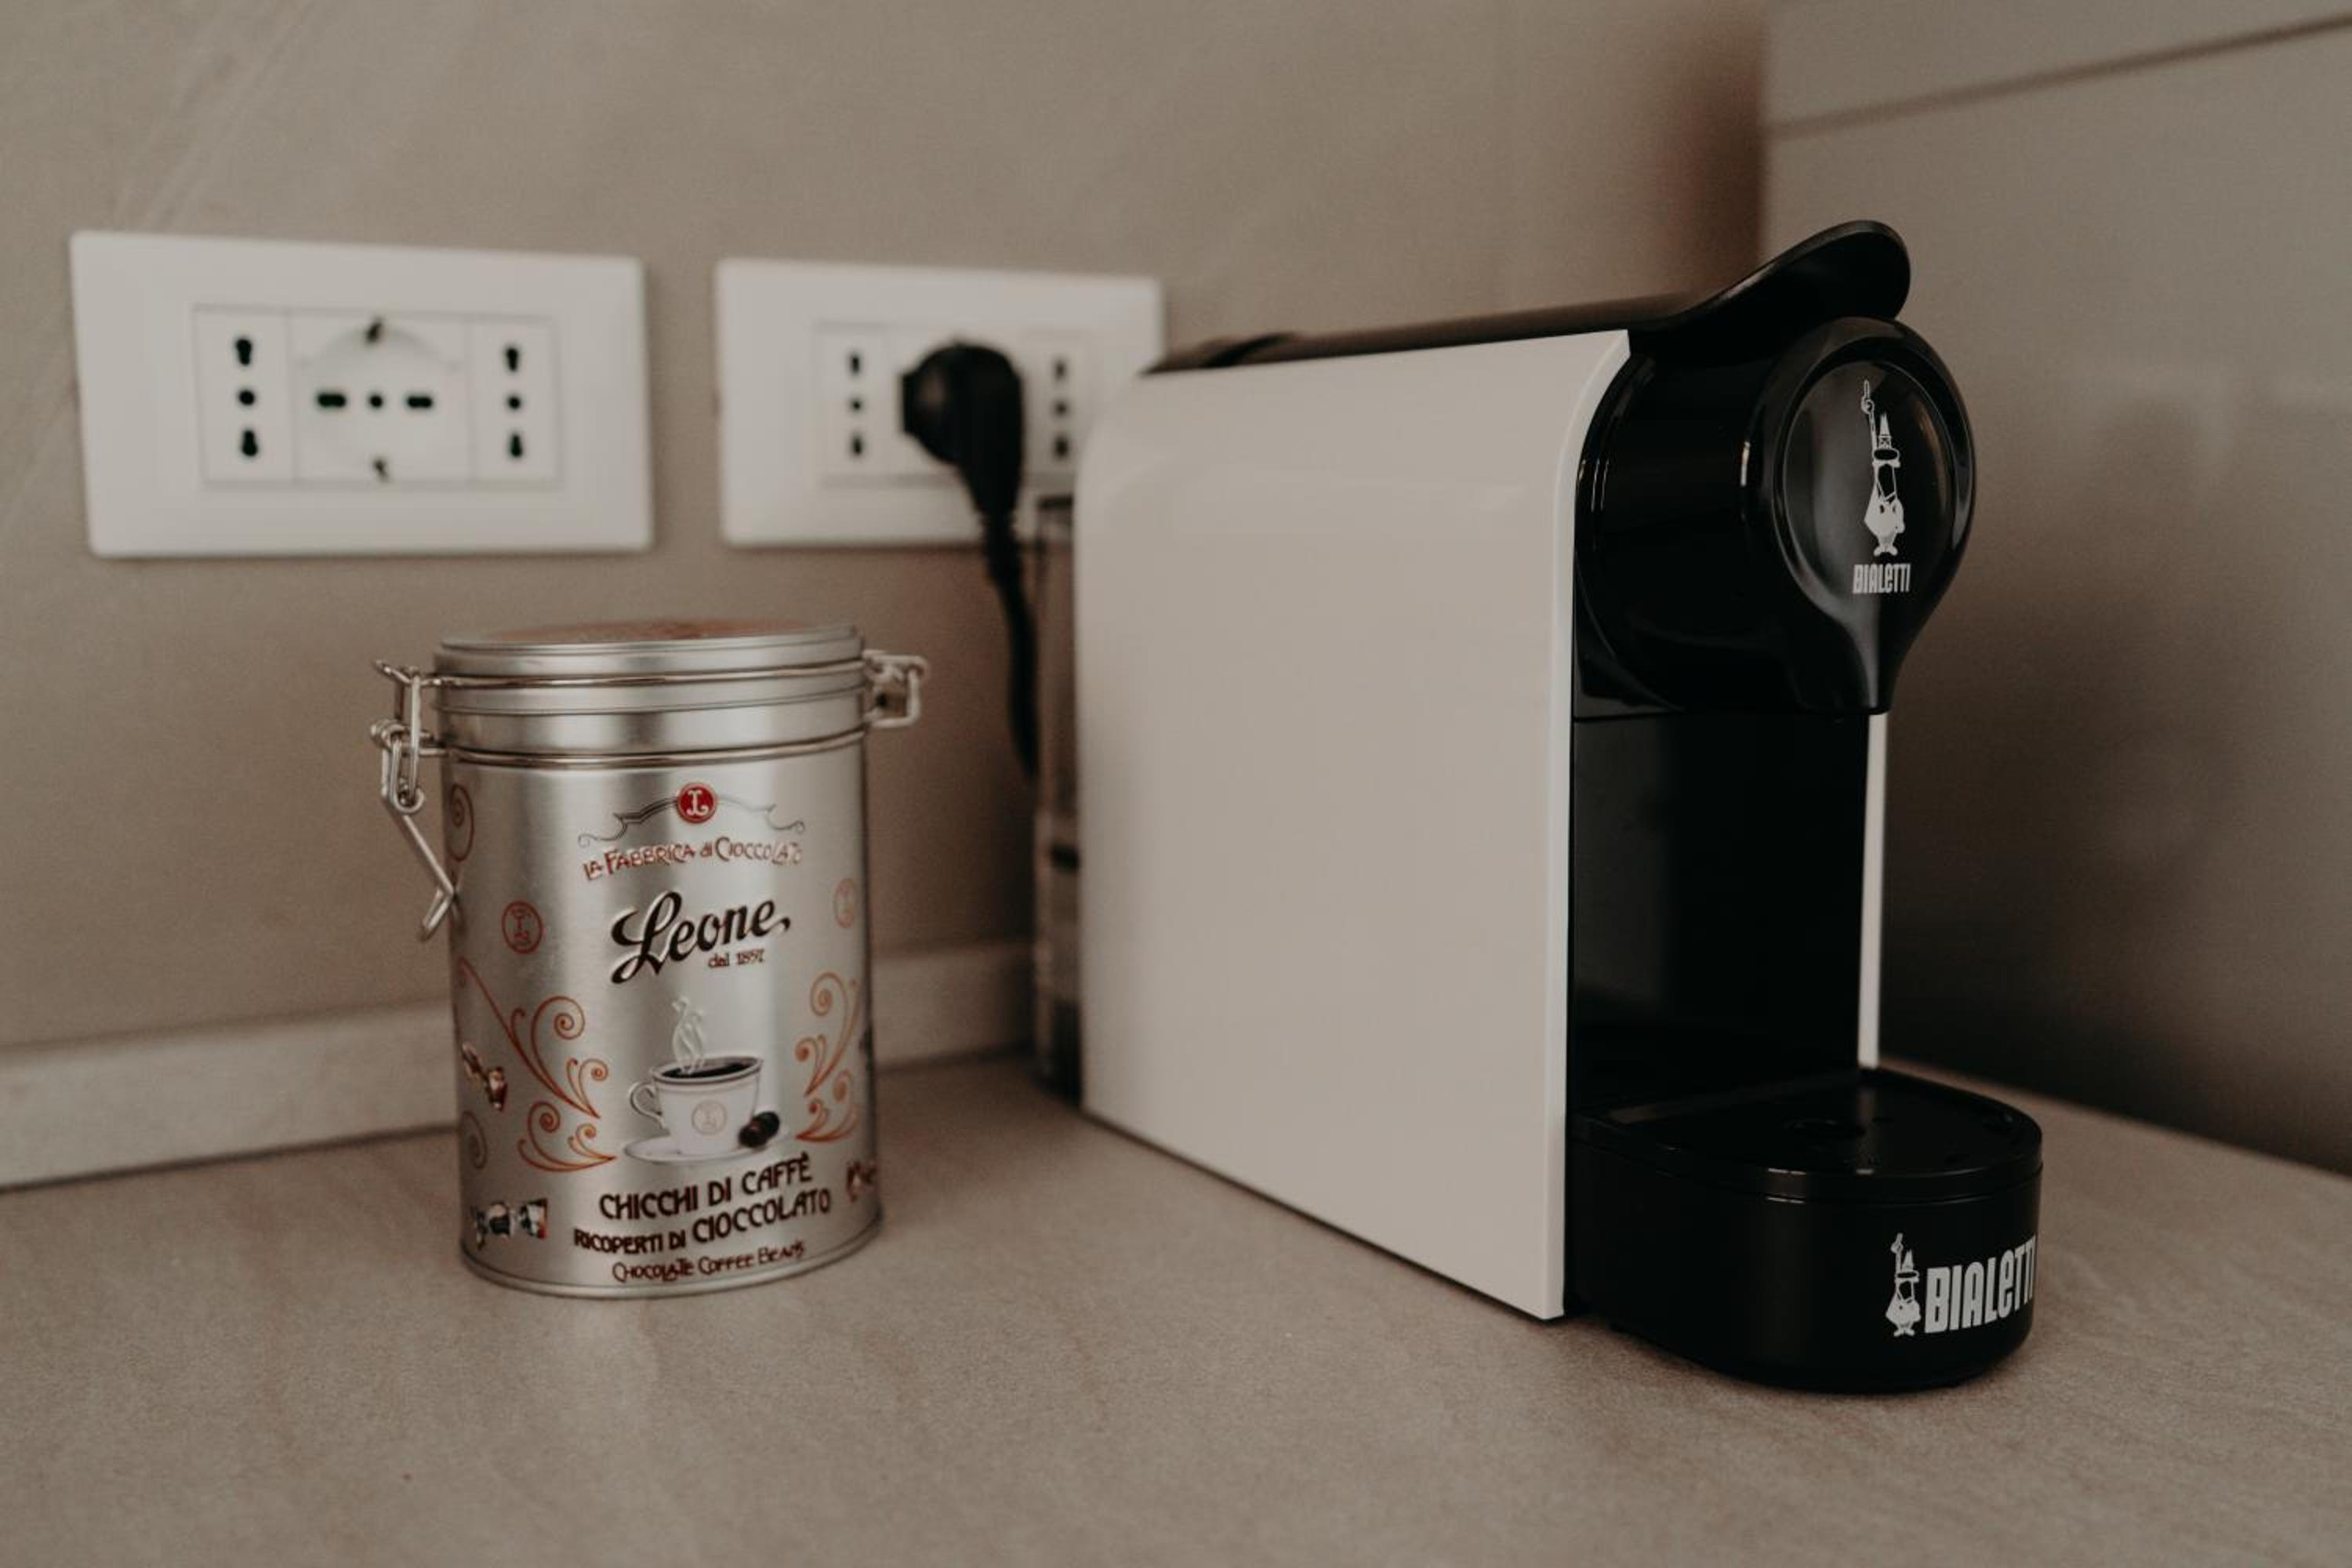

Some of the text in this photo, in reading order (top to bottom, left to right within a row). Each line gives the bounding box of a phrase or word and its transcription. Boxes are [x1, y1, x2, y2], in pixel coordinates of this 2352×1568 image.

[583, 861, 604, 880] LA
[604, 844, 695, 875] FABBRICA
[611, 891, 791, 985] Leone
[708, 951, 730, 968] dal
[599, 1151, 812, 1220] CHICCHI DI CAFFÈ
[574, 1187, 831, 1254] RICOPERTI DI CIOCCOLATO
[698, 1255, 754, 1276] COFFEE
